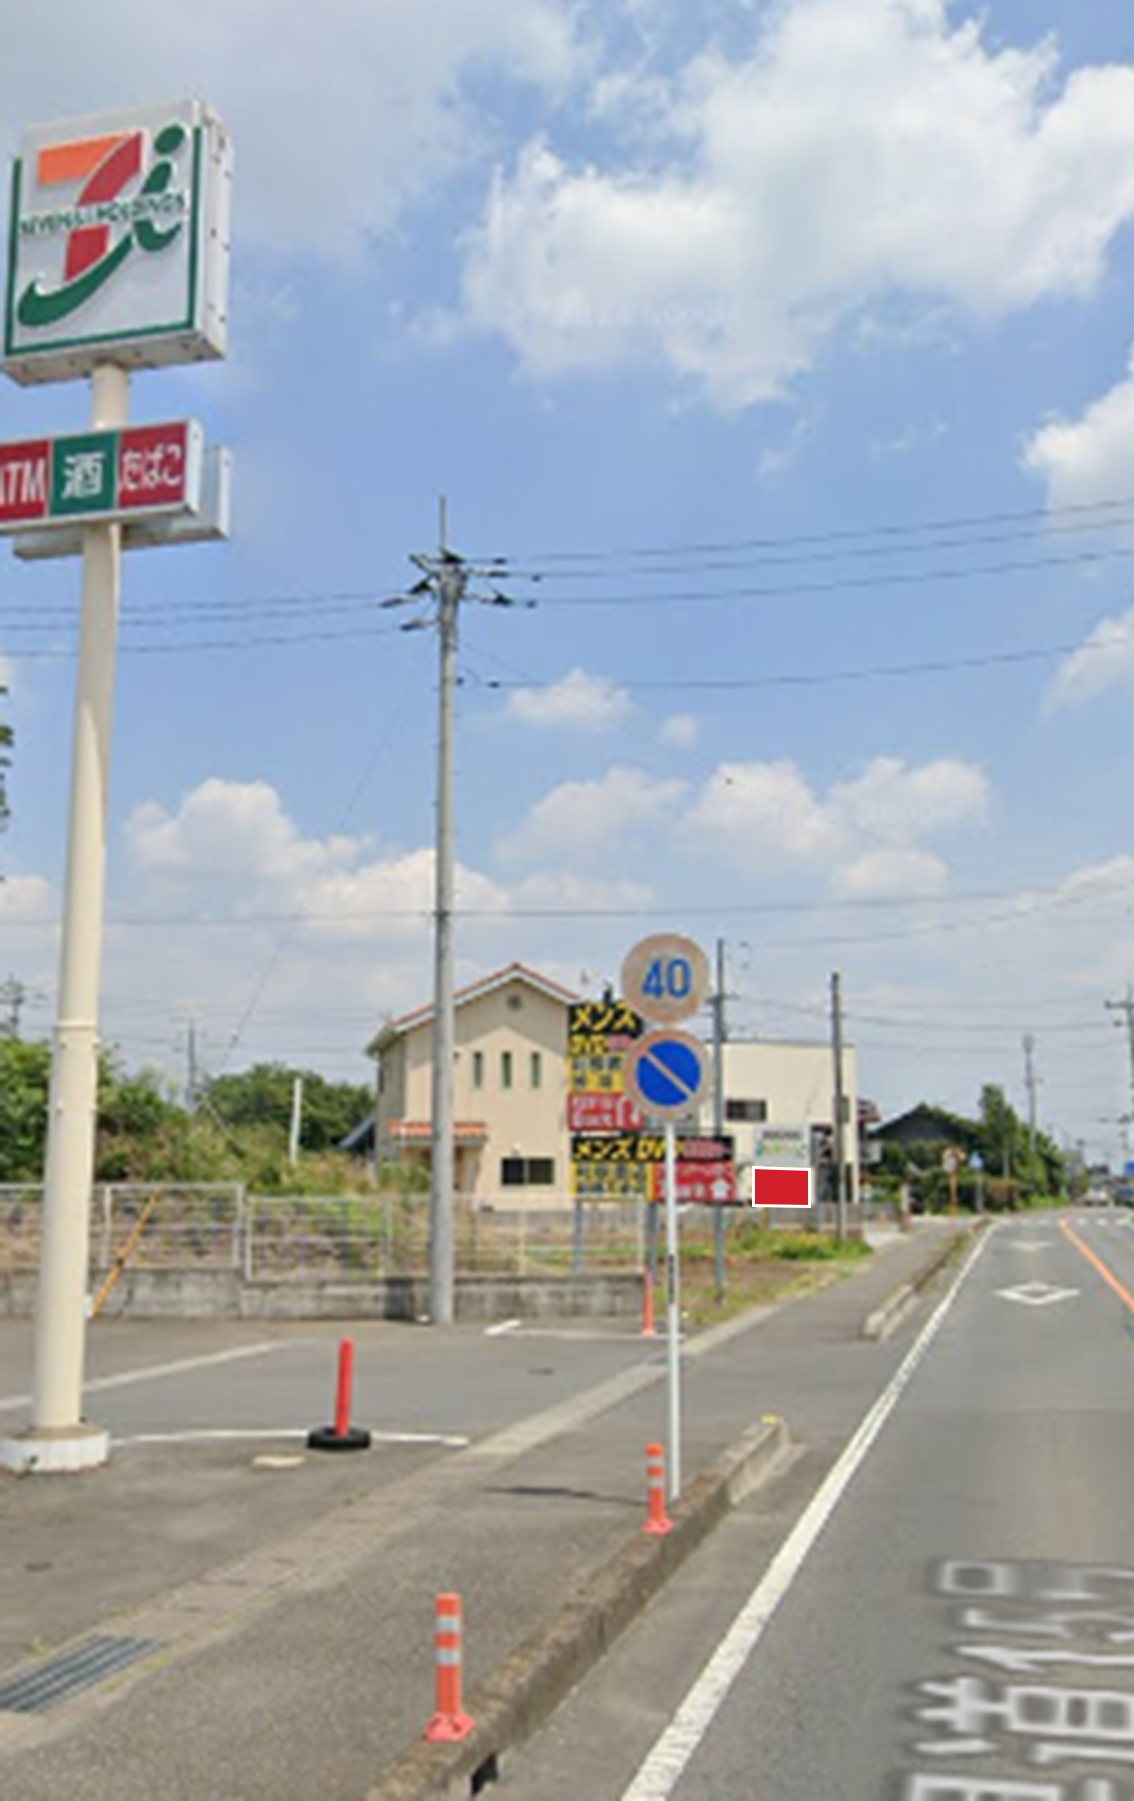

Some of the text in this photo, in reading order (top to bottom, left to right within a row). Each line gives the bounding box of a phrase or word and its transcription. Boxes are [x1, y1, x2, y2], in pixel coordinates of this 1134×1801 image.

[61, 451, 106, 500] 酒
[121, 442, 183, 492] たばこ
[641, 957, 692, 998] 40
